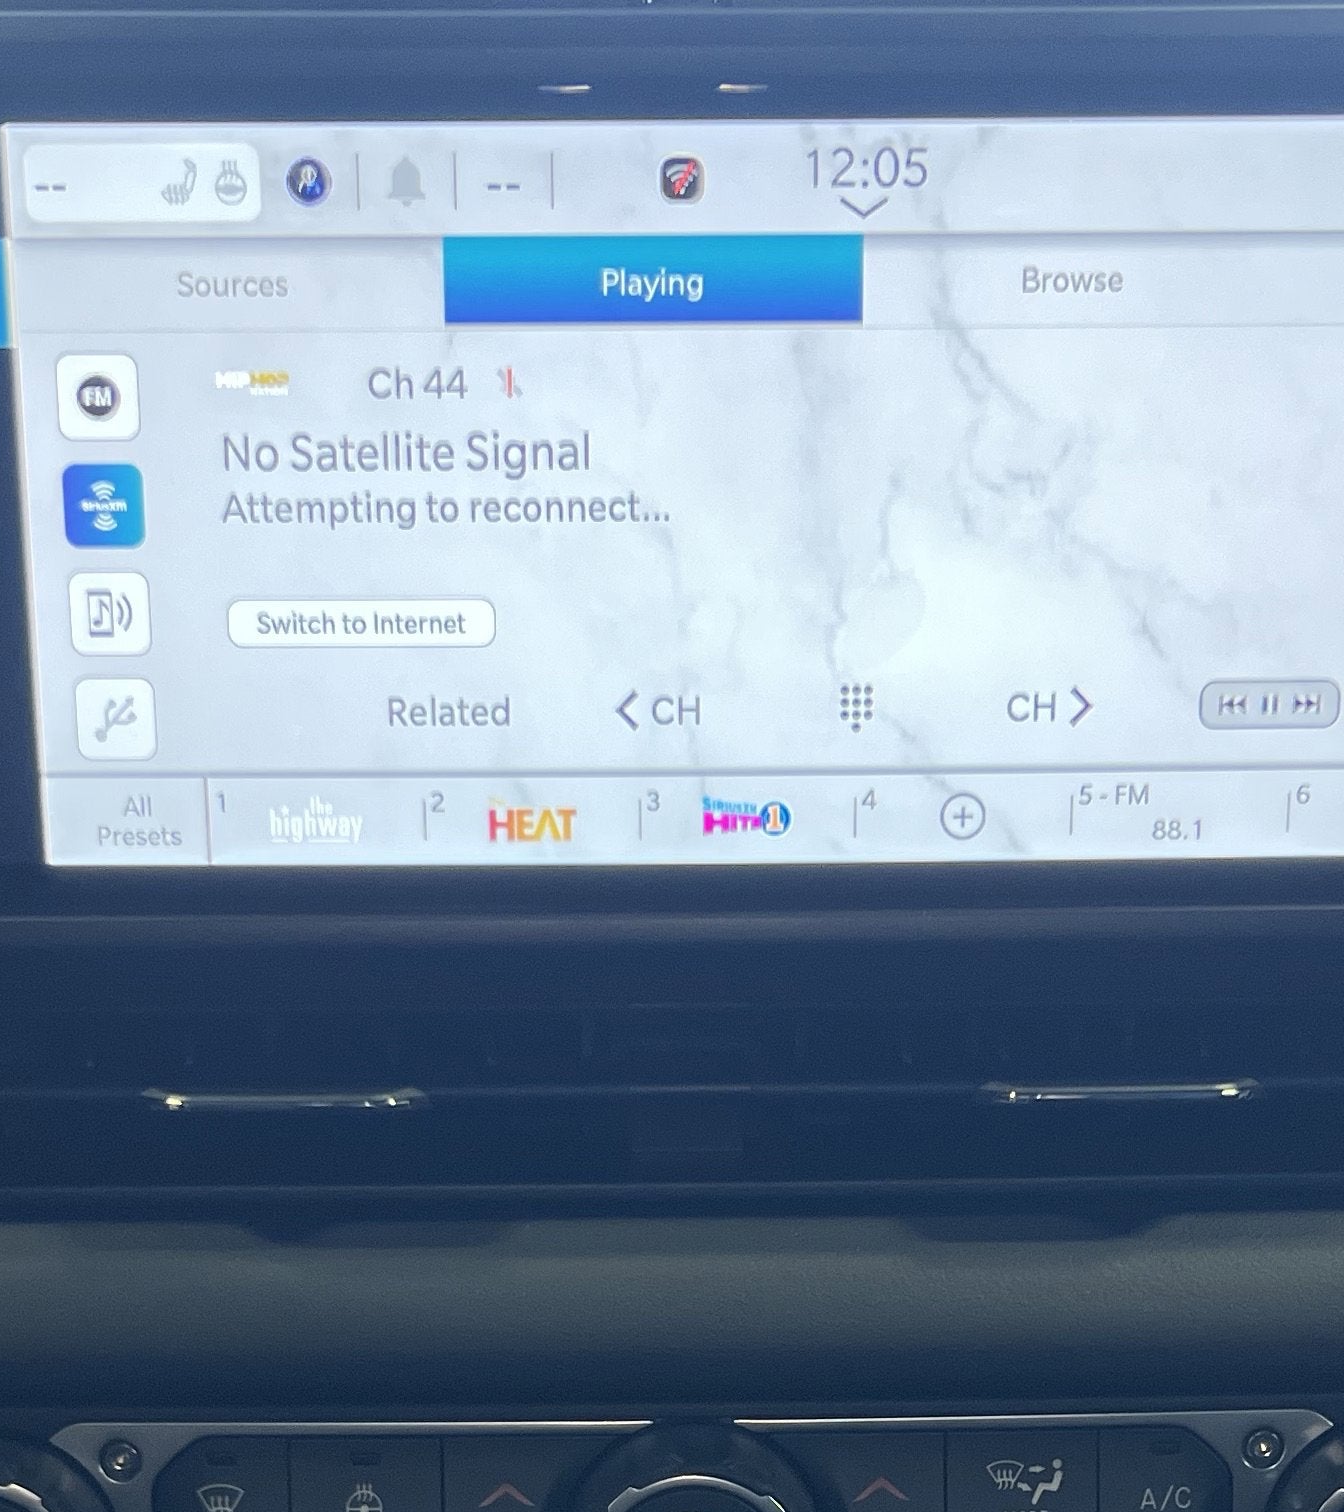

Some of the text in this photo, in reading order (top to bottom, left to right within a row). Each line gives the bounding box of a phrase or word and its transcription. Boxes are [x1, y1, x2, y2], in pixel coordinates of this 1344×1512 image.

[805, 146, 929, 190] 12:05
[176, 271, 289, 298] Sources
[601, 266, 704, 301] Playing
[1021, 265, 1124, 293] Browse
[368, 366, 469, 400] Ch 44
[80, 385, 112, 407] FM
[223, 430, 590, 479] No Satellite Signal
[222, 489, 671, 530] Attempting to reconnect...
[256, 611, 467, 636] Switch to Internet
[388, 696, 511, 727] Related
[652, 696, 701, 726] CH
[1007, 693, 1056, 723] CH
[123, 795, 152, 818] All
[217, 793, 227, 814] 1
[430, 793, 445, 814] 2
[647, 789, 661, 812] 3
[861, 788, 877, 809] 4
[1079, 785, 1092, 806] 5
[1115, 785, 1150, 806] FM
[1296, 784, 1311, 804] 6
[310, 797, 332, 818] the
[97, 825, 183, 850] Presets
[269, 808, 363, 844] highway
[488, 808, 577, 842] HEAT
[1152, 819, 1202, 840] 88.1
[1140, 1487, 1193, 1511] A/C
